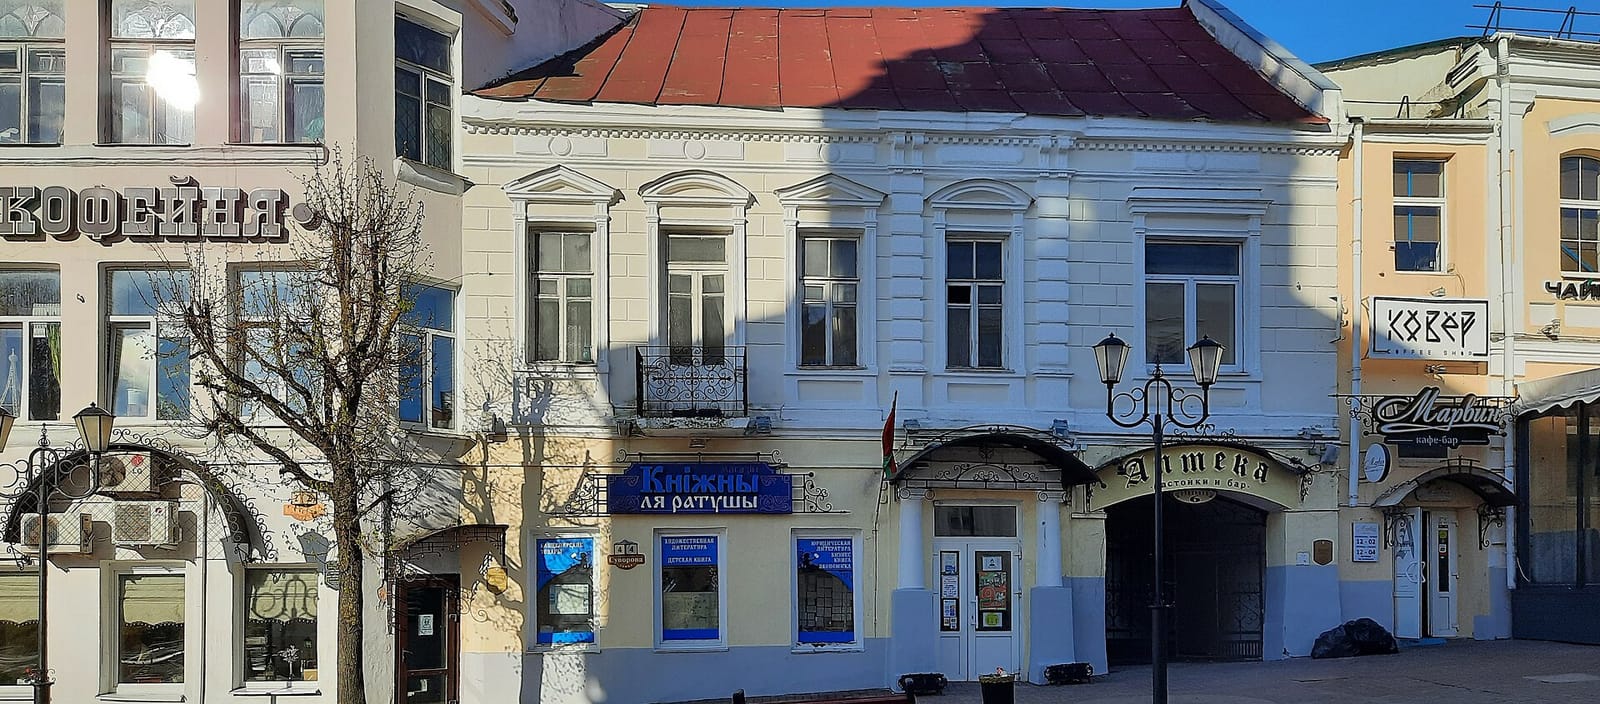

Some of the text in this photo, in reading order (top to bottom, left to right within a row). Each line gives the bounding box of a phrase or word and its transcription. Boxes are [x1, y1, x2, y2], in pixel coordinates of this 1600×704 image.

[0, 175, 285, 241] КОФЕЙНЯ
[1377, 386, 1500, 431] Марвин
[1416, 435, 1459, 446] кафе-бар
[640, 466, 758, 493] Кніжны
[641, 495, 757, 512] ля ратушы
